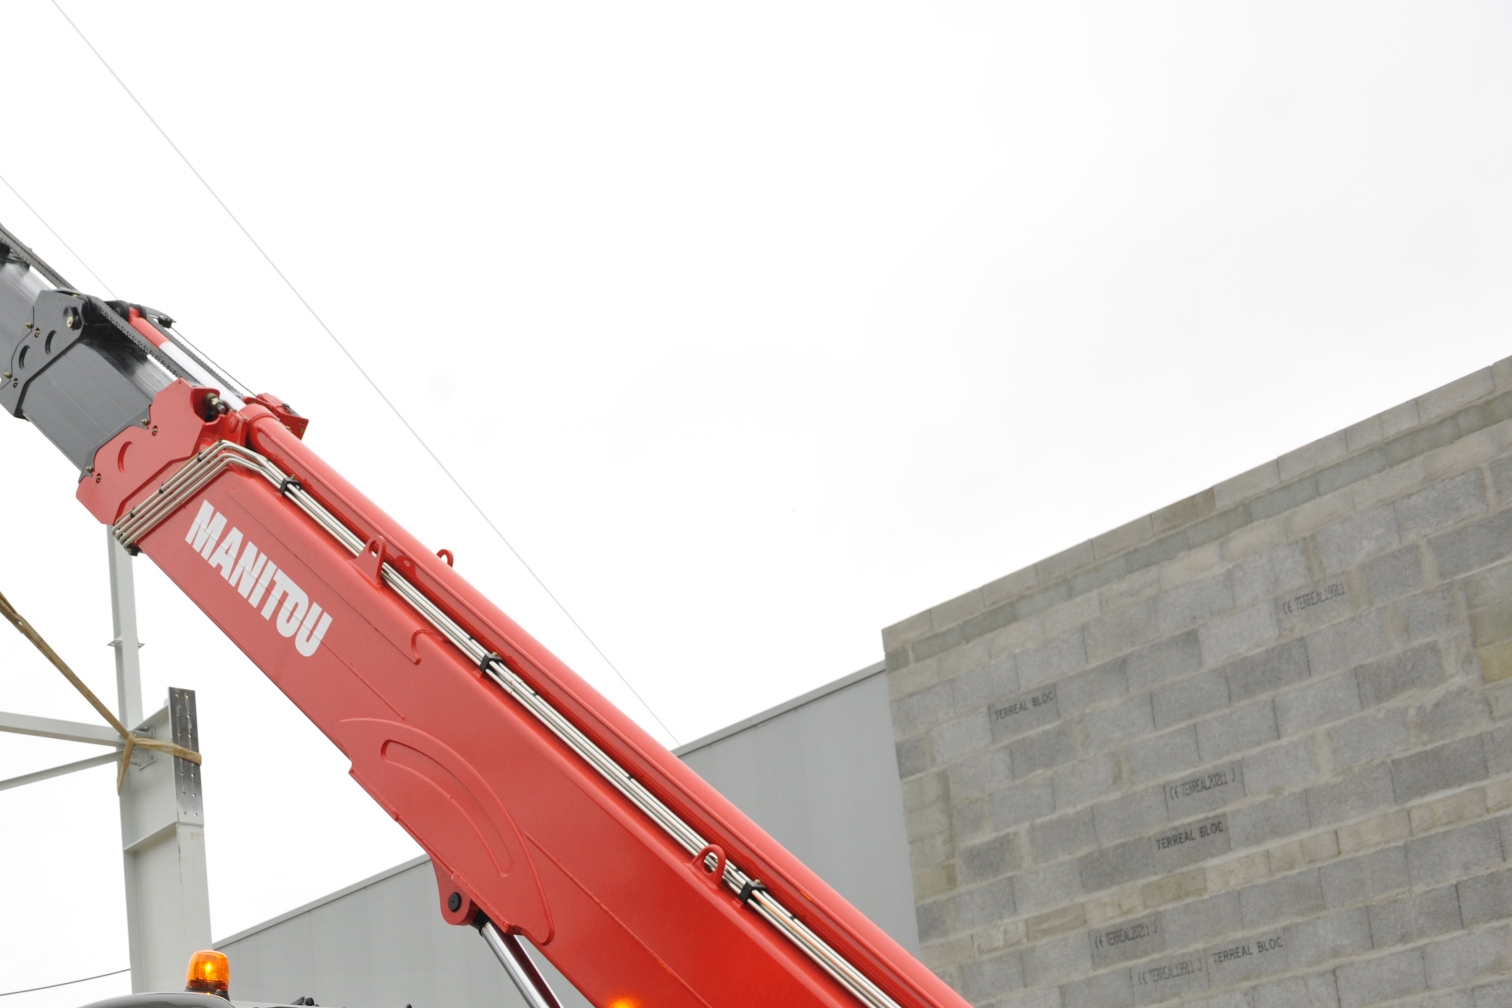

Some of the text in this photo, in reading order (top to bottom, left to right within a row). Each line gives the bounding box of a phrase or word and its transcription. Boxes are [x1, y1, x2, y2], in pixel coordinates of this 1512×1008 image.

[185, 499, 334, 657] MANITOU
[994, 690, 1055, 721] TERREAL BLOC
[1154, 820, 1225, 851] TERREAL BLOC
[1211, 936, 1284, 964] TERREAL BLOC
